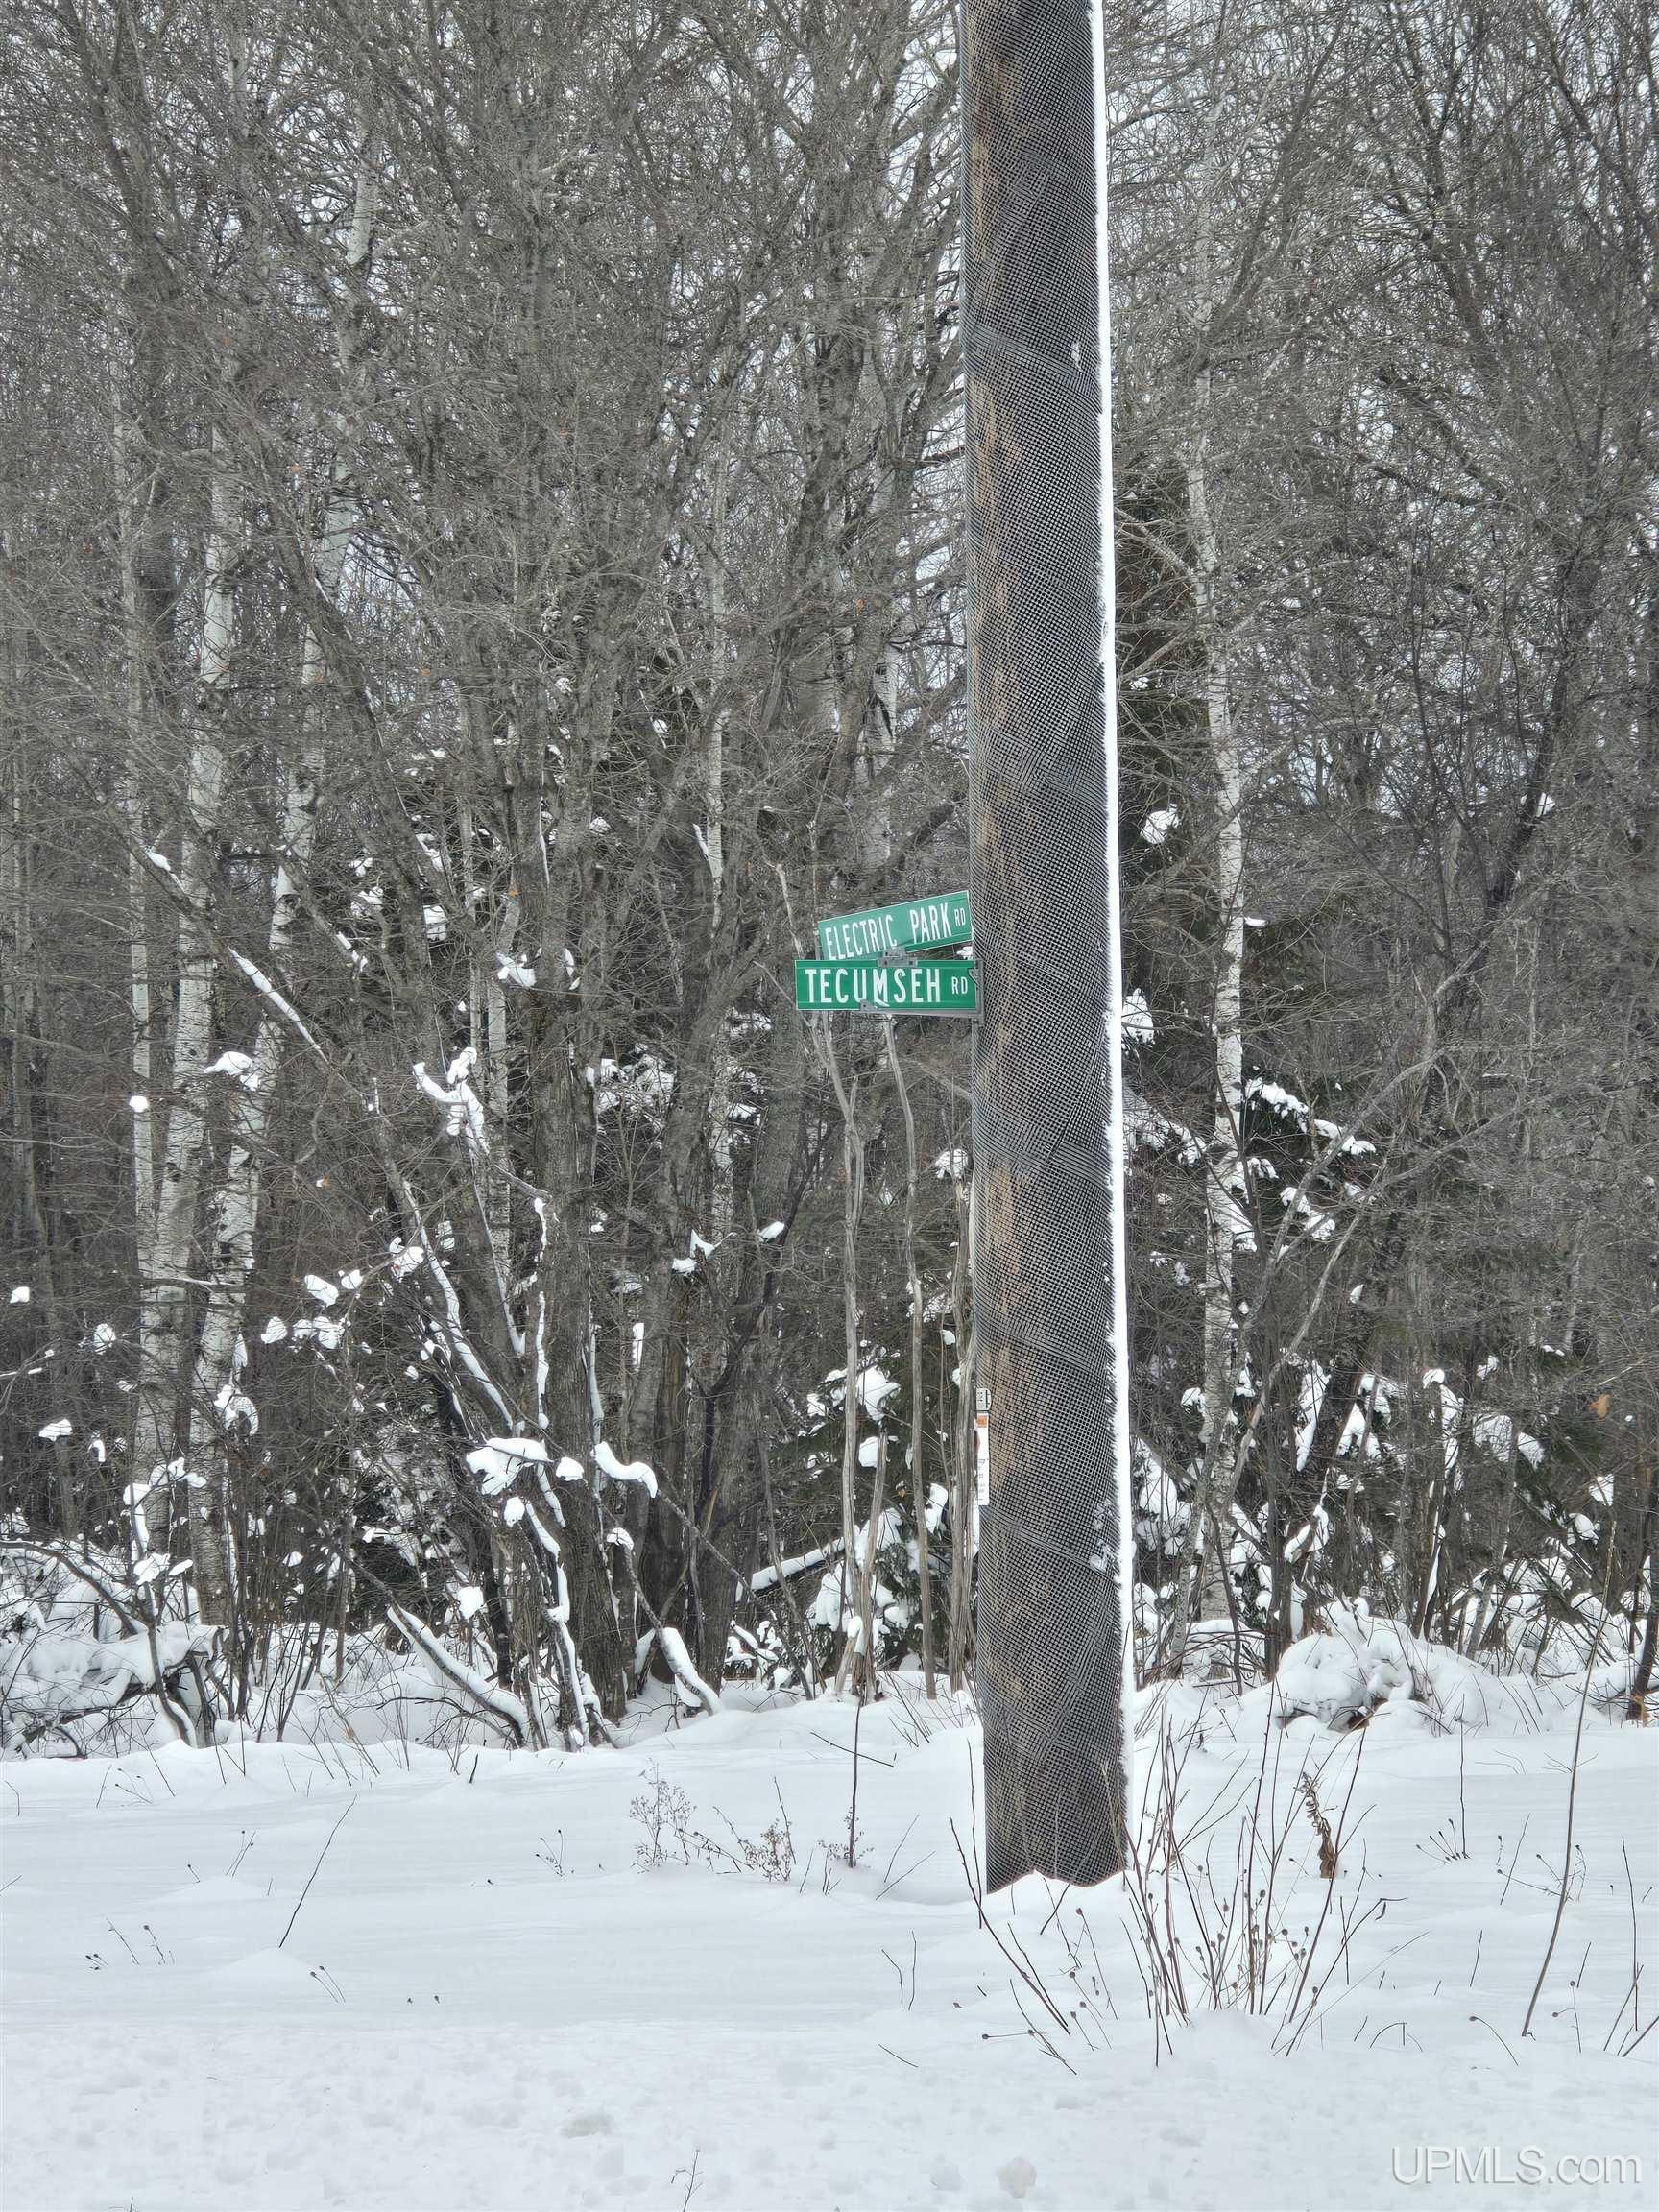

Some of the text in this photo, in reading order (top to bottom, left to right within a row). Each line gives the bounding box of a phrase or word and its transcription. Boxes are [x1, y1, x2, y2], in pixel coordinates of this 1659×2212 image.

[825, 902, 966, 960] ELECTRIC PARK RD
[805, 968, 968, 1003] TECUMSEH RD
